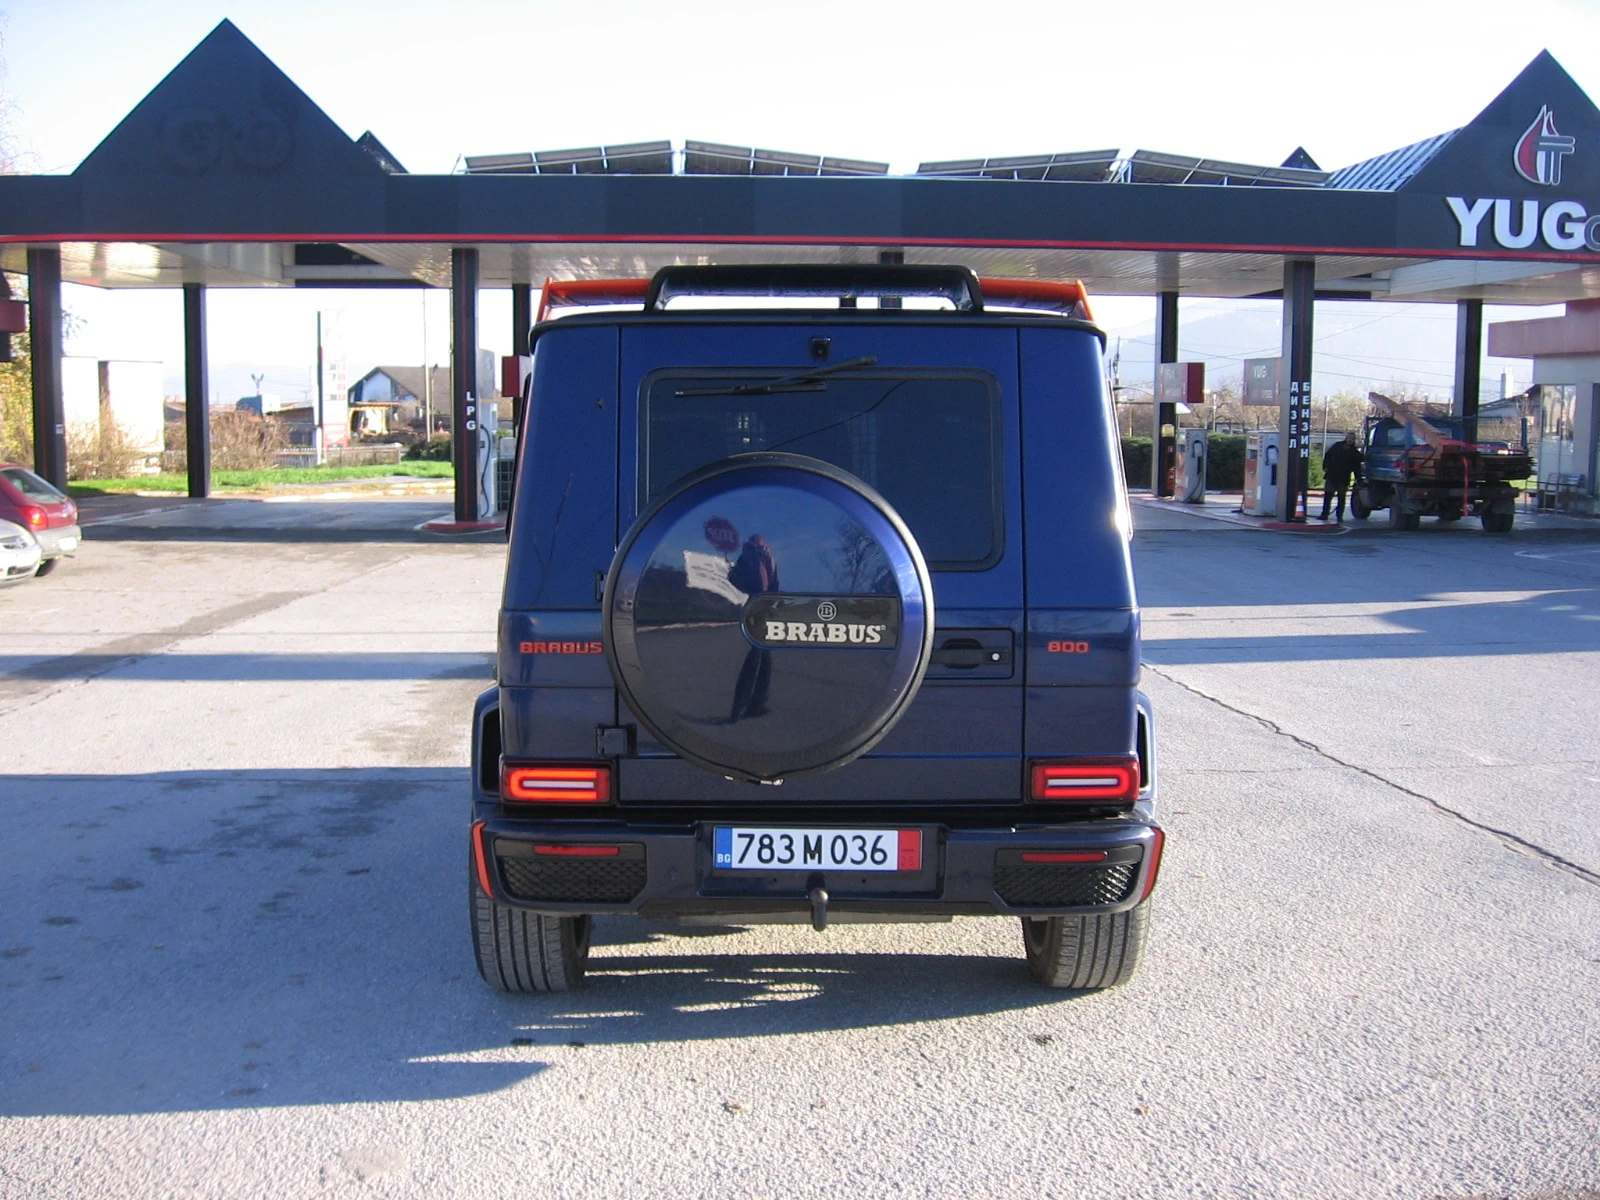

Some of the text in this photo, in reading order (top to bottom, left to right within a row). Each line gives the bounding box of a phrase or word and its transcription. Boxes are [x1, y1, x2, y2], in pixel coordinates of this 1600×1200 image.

[466, 391, 476, 430] LPG
[1289, 381, 1299, 449] ДИЗЕЛ
[1300, 381, 1311, 458] БЕНЗИН
[765, 621, 881, 643] BRABUS
[519, 641, 603, 654] BRABUS
[1047, 641, 1090, 654] 800
[717, 853, 731, 863] BG
[737, 833, 888, 866] 783 M 036
